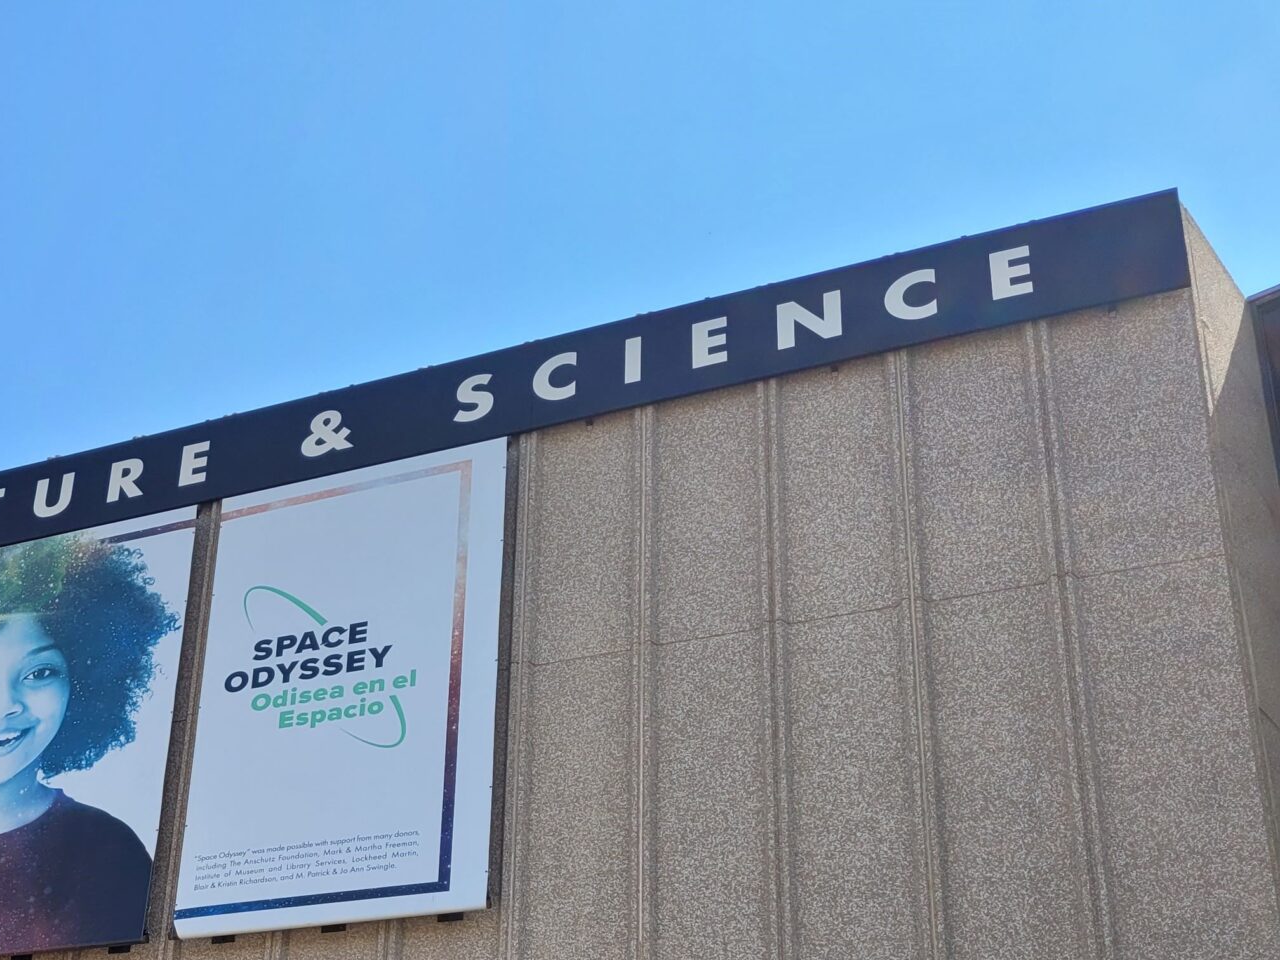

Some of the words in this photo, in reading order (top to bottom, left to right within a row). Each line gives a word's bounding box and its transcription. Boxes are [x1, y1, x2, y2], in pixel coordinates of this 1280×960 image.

[301, 409, 353, 458] &
[453, 244, 1034, 423] SCIENCE
[252, 621, 368, 661] SPACE
[224, 645, 393, 693] ODYSSEY
[250, 685, 345, 712] Odisea
[352, 678, 385, 696] en
[392, 669, 417, 689] el
[278, 698, 384, 729] Espacio
[235, 867, 264, 876] Museum
